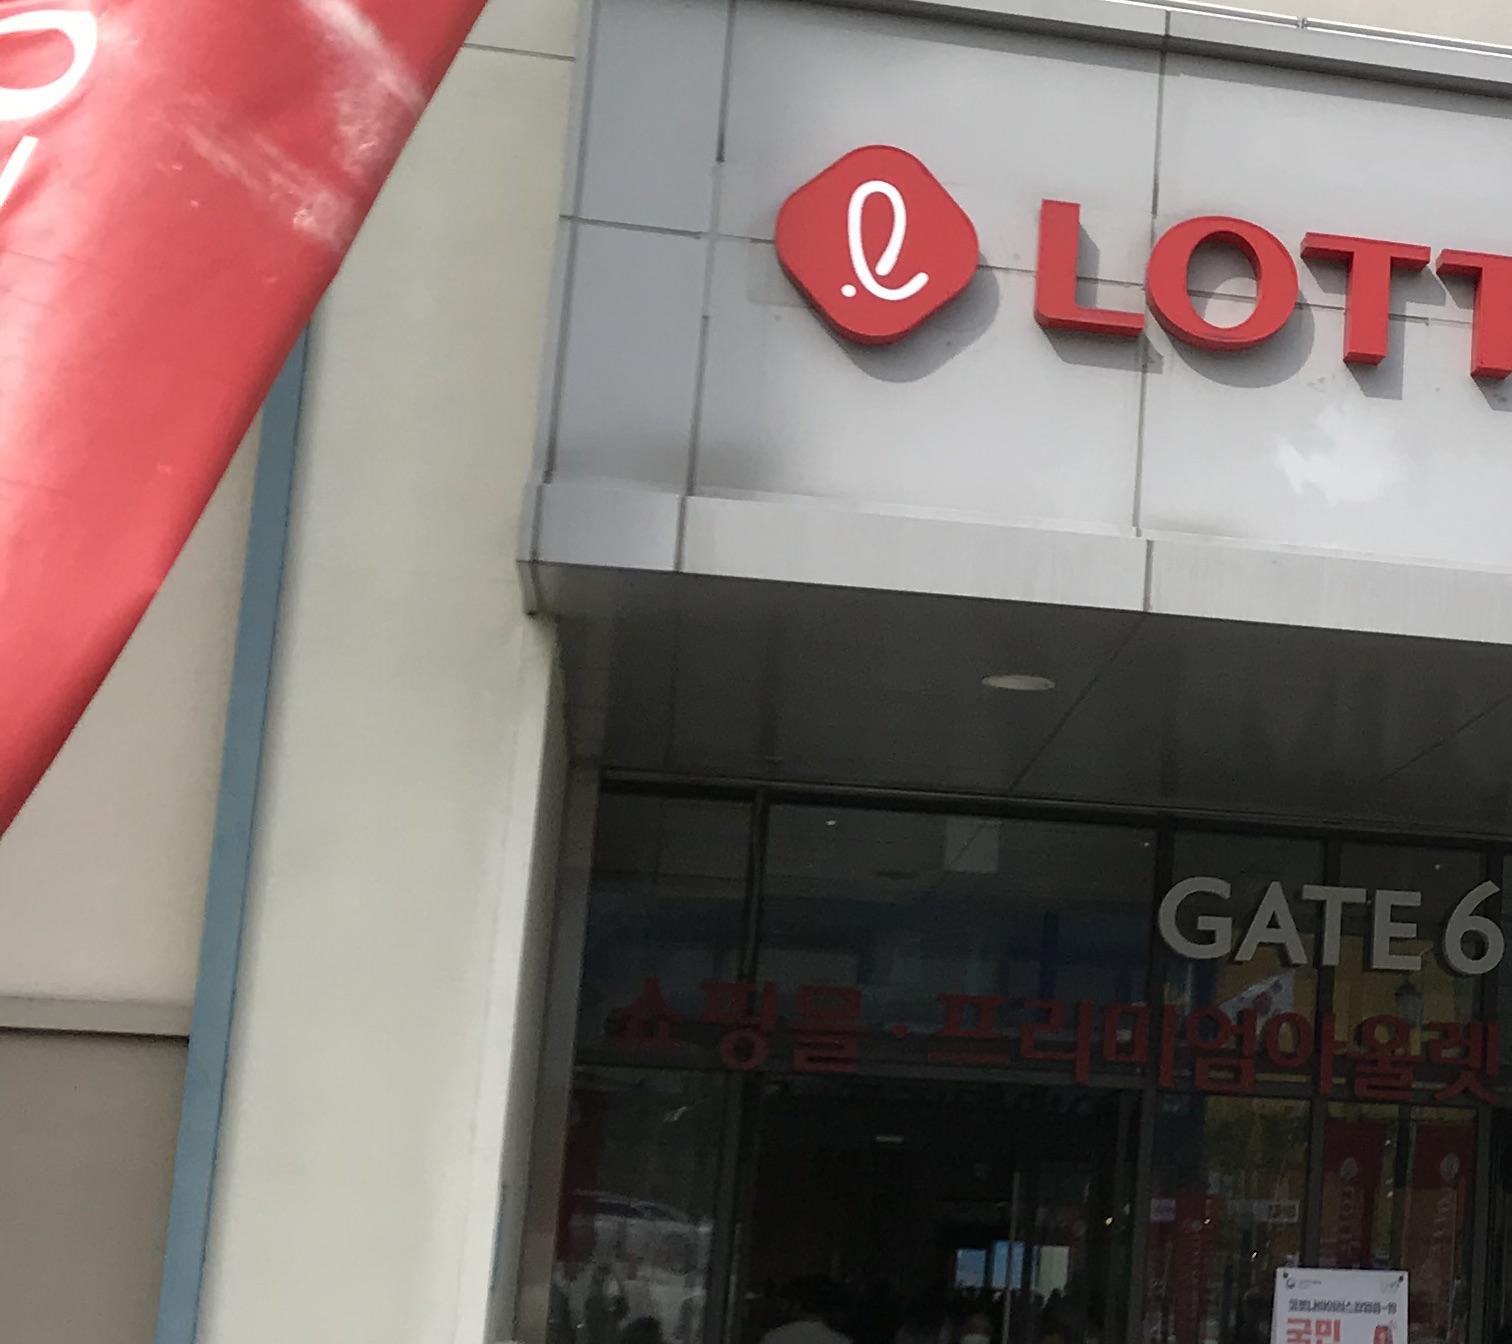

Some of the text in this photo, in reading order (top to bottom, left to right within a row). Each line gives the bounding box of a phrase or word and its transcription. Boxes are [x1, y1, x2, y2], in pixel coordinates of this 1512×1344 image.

[1158, 876, 1505, 976] GATE 6
[608, 976, 871, 1074] 쇼핑몰
